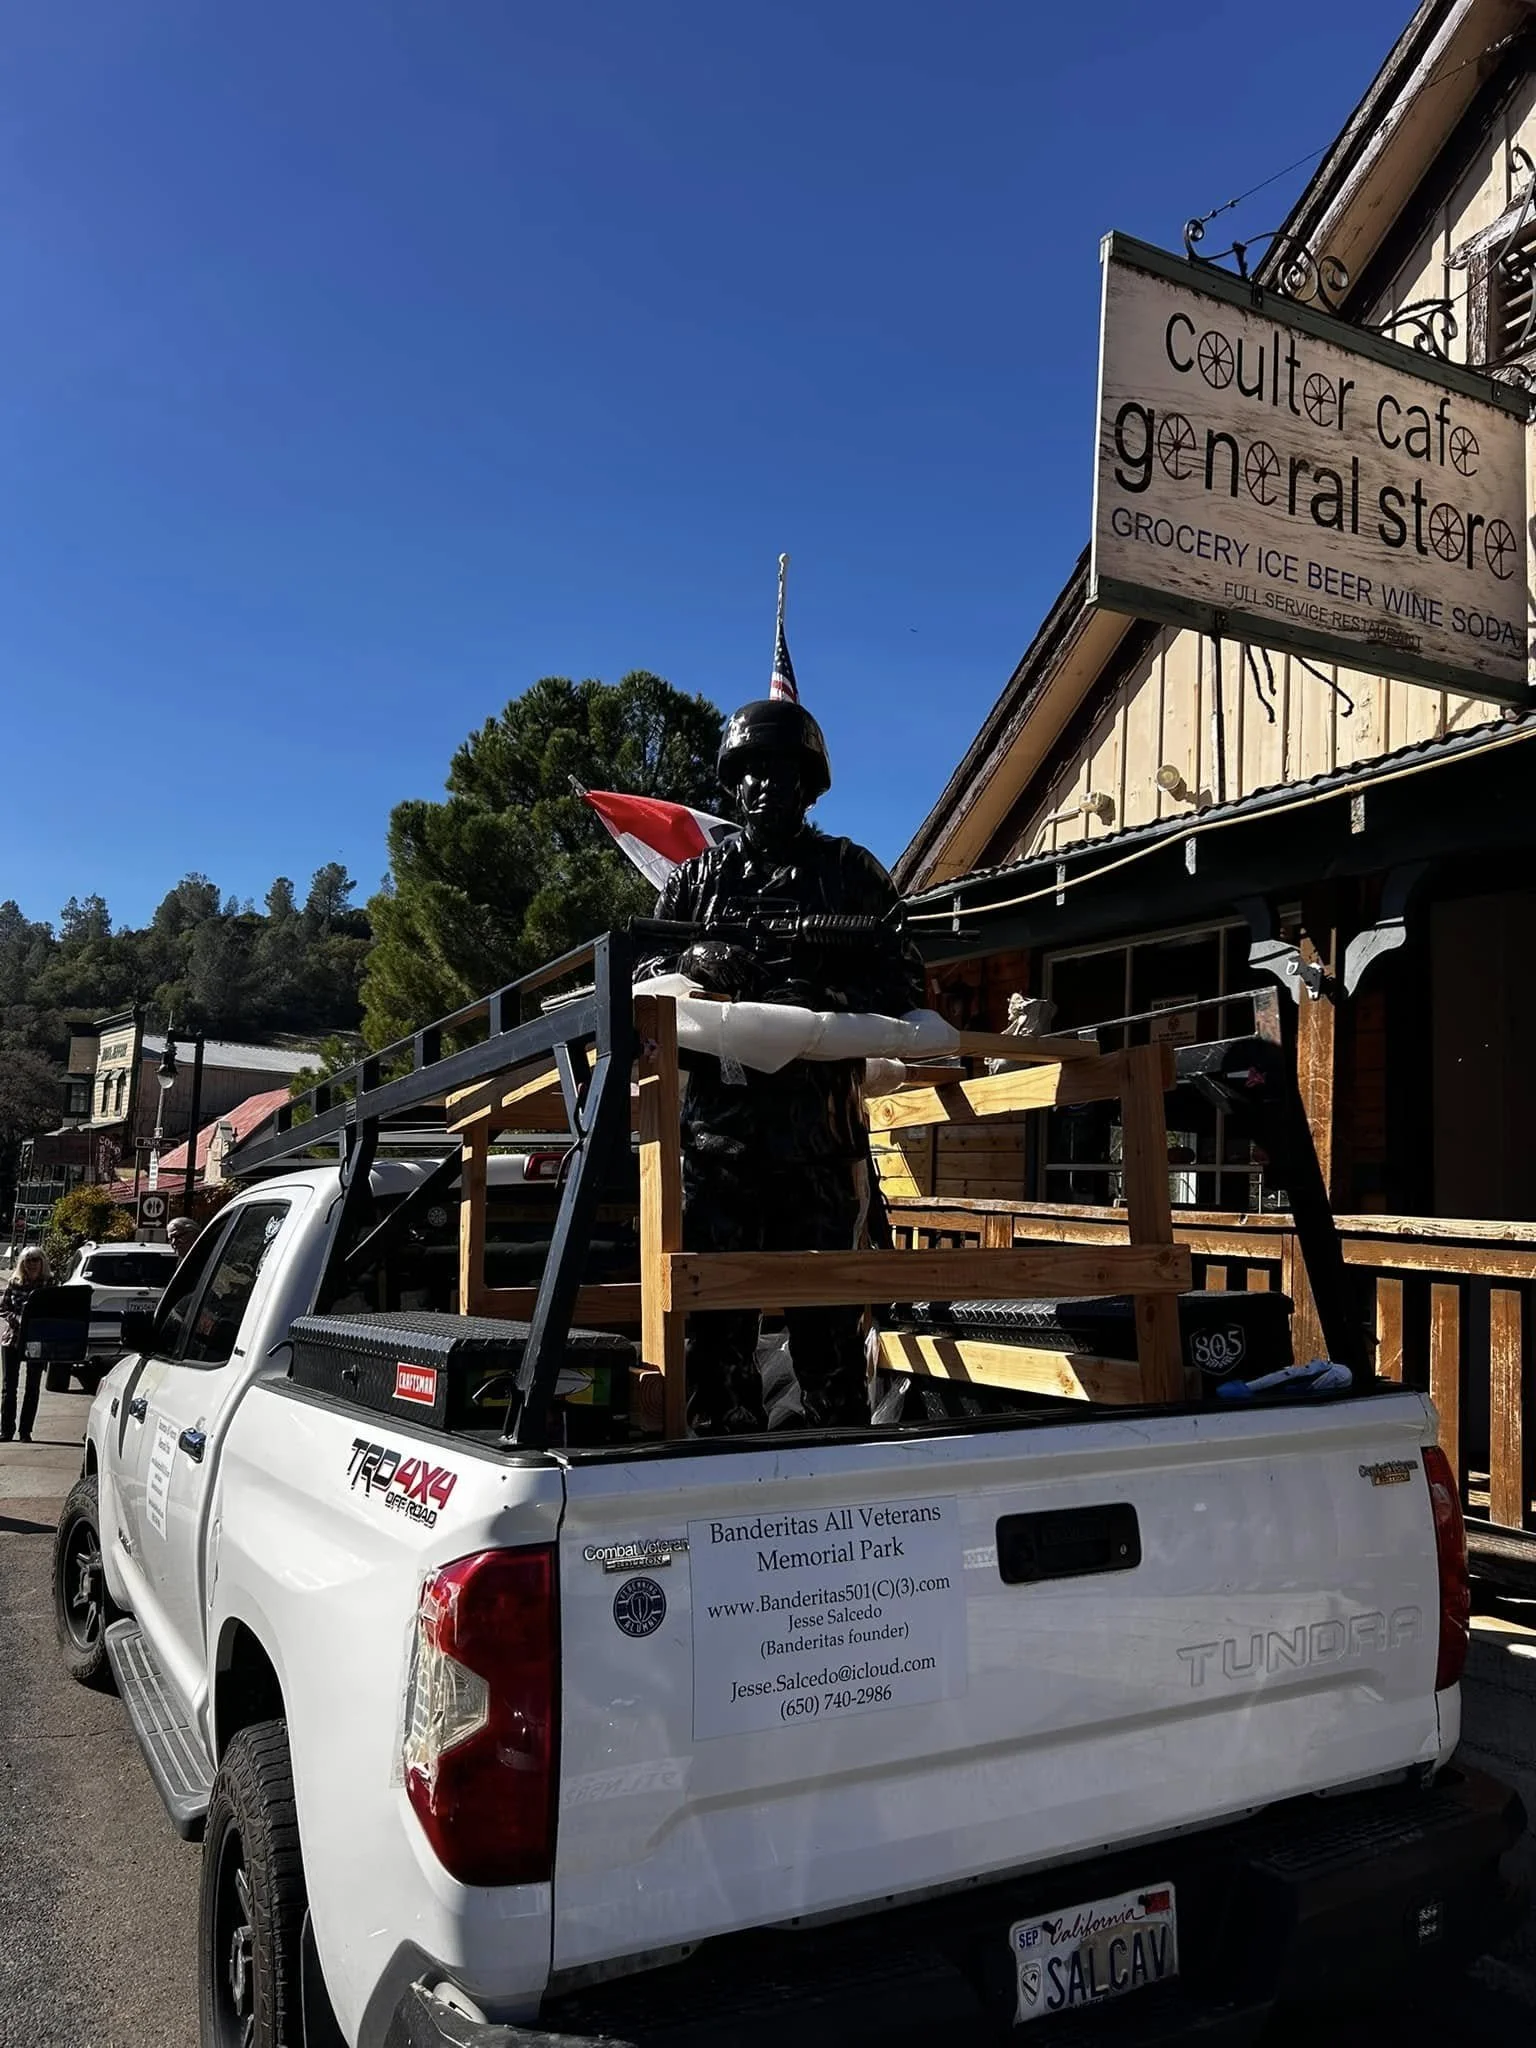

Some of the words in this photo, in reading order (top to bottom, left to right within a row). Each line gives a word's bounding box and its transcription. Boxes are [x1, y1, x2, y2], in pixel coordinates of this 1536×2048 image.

[1166, 312, 1355, 430] coulter
[1377, 394, 1479, 478] cafe
[1114, 401, 1359, 535] general
[1377, 478, 1517, 580] store
[1111, 506, 1250, 568] GROCERY
[1257, 546, 1299, 583] ICE
[1307, 562, 1373, 606] BEER
[1382, 584, 1443, 627] WINE
[1451, 606, 1518, 648] SODA
[1224, 582, 1263, 604] FULL
[1265, 592, 1328, 622] SERVICE
[1195, 1330, 1242, 1362] 805
[398, 1371, 435, 1395] CRAFTSMAN
[346, 1438, 402, 1498] TRD
[384, 1491, 408, 1513] OFF
[405, 1500, 438, 1529] ROAD
[709, 1518, 819, 1545] Banderitas
[824, 1511, 853, 1533] All
[858, 1504, 942, 1529] Veterans
[583, 1544, 637, 1561] Combat
[640, 1538, 690, 1555] Veteran
[757, 1541, 854, 1573] Memorial
[860, 1536, 905, 1561] Park
[708, 1575, 951, 1619] www.Banderitas501(C)(3).com
[787, 1614, 824, 1632] Jesse
[827, 1604, 883, 1626] Salcedo
[760, 1633, 845, 1660] (Banderitas
[848, 1622, 909, 1646] founder)
[1177, 1605, 1423, 1688] TUNDRA
[730, 1654, 937, 1702] Jesse.Salcedo@icloud.com
[780, 1694, 820, 1721] (650)
[824, 1685, 893, 1711] 740-2986
[1018, 1929, 1039, 1949] SEP
[1050, 1903, 1146, 1946] California
[1047, 1923, 1168, 2010] SALCAV
